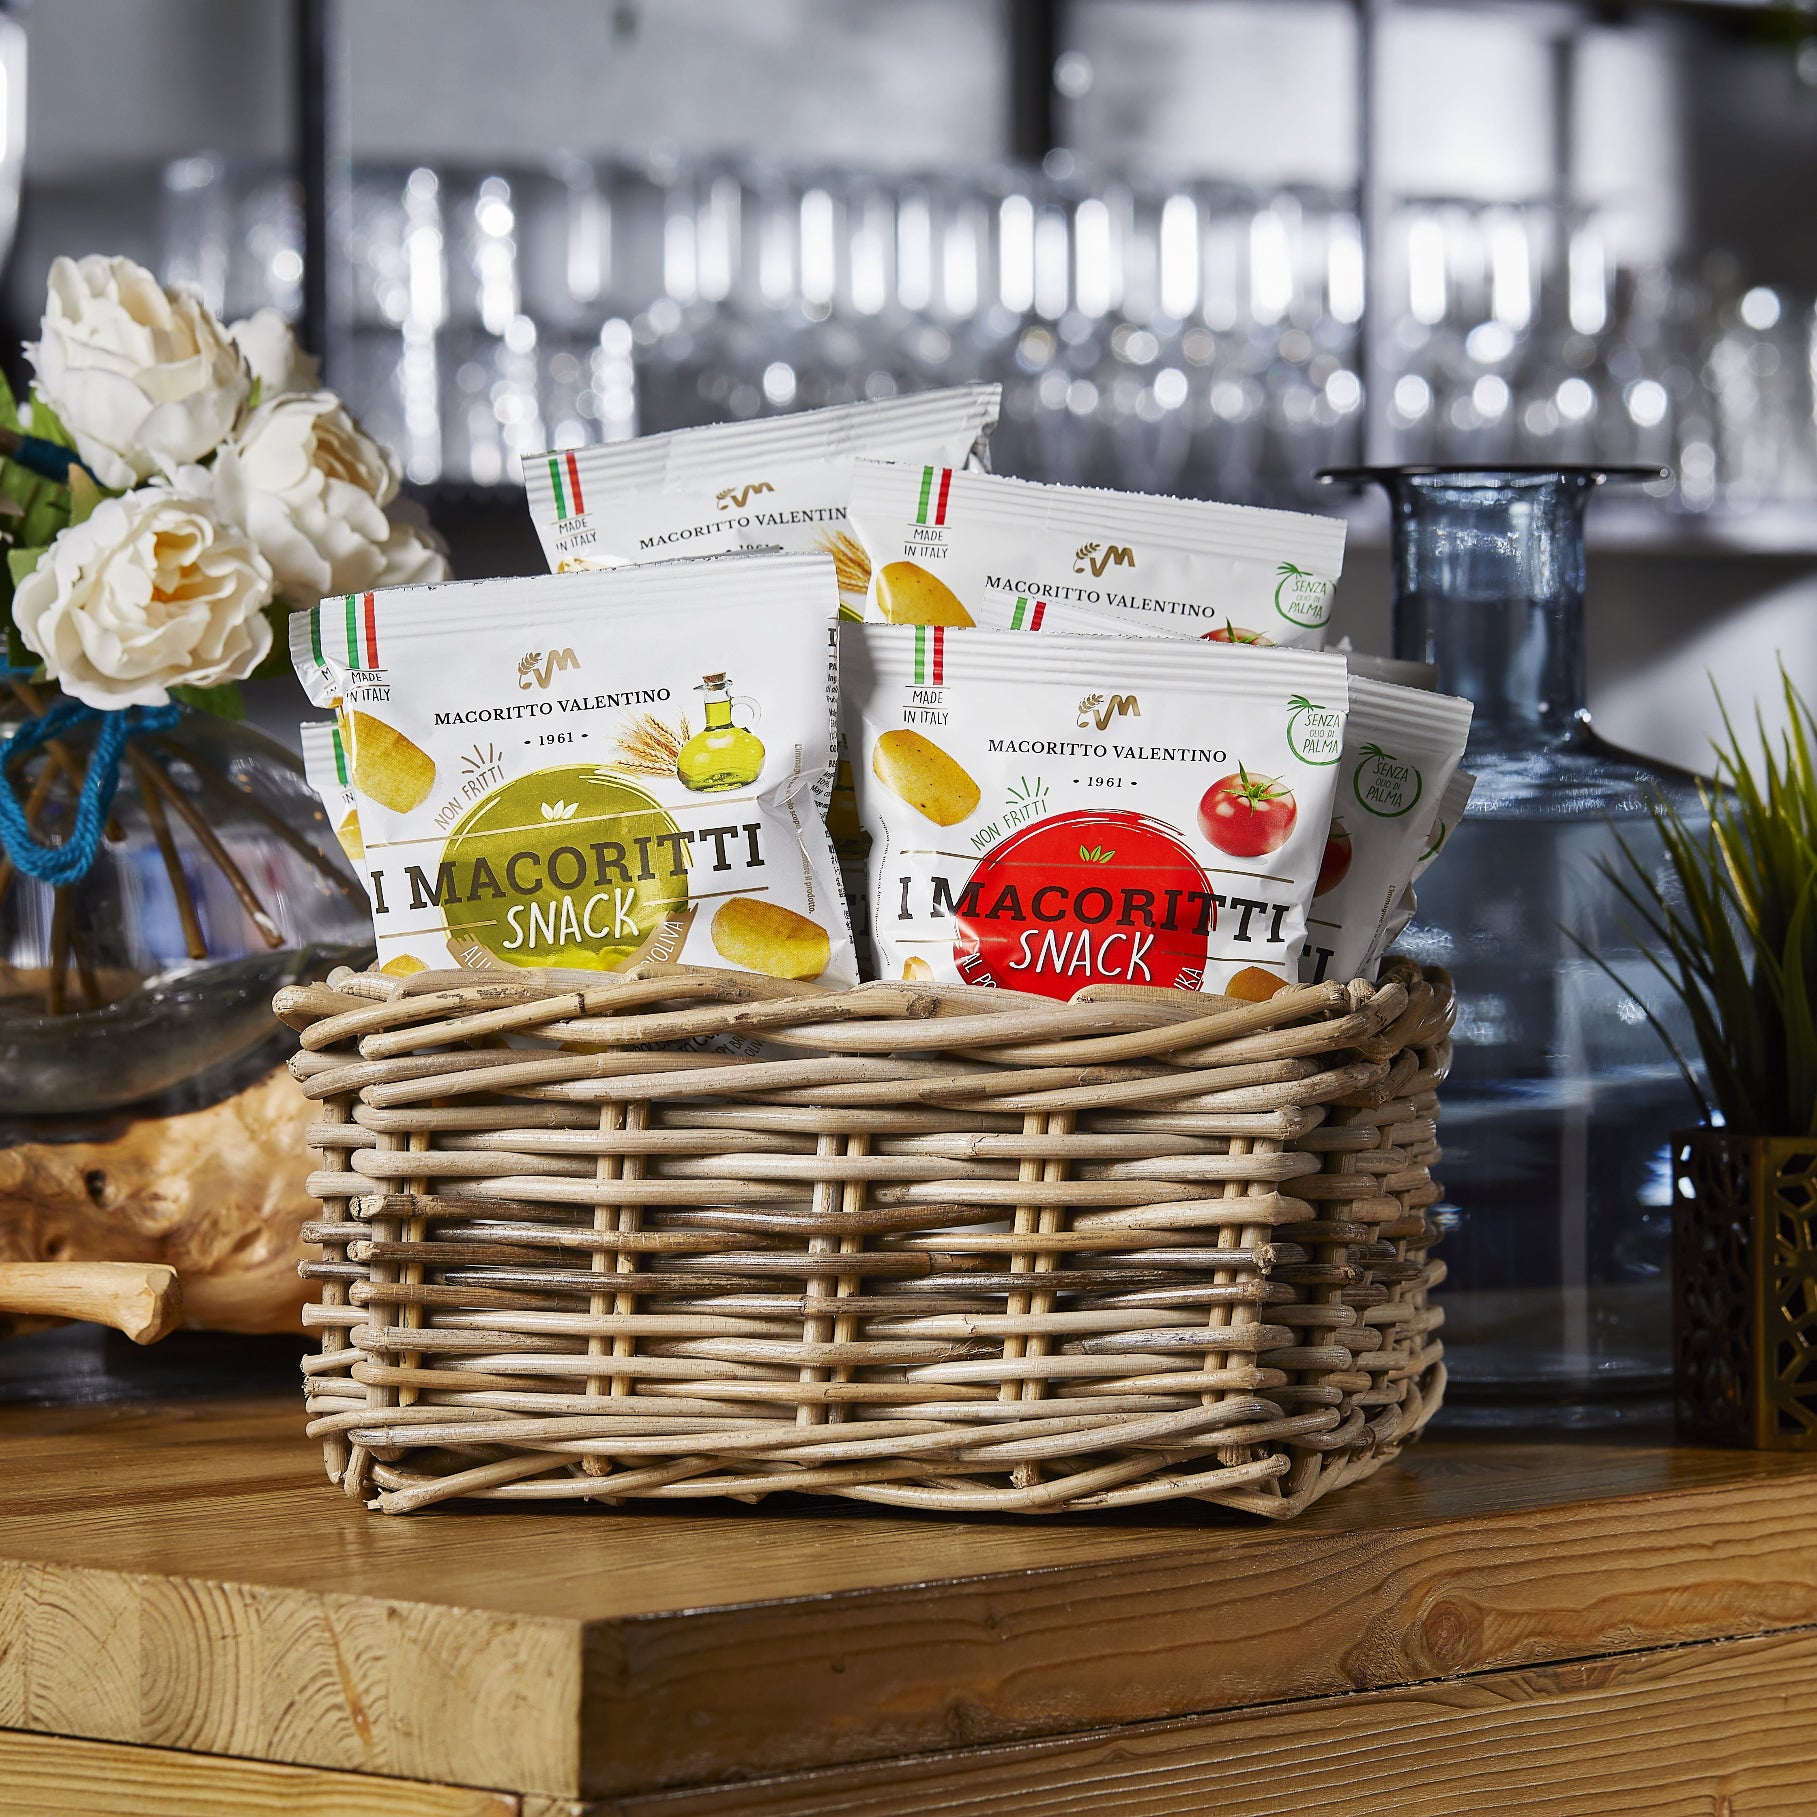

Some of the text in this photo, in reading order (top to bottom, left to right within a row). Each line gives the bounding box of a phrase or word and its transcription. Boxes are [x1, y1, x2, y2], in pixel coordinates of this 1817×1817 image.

[558, 518, 588, 534] MADE
[639, 506, 848, 550] MACORITTO VALENTIN
[912, 528, 944, 542] MADE
[555, 531, 597, 552] IN ITALY
[904, 545, 949, 560] IN ITALY
[1292, 580, 1327, 595] SENZA
[985, 575, 1216, 620] MACORITTO VALENTINO
[1288, 601, 1323, 620] PALMA
[351, 671, 382, 684] MADE
[362, 688, 390, 702] ITALY
[912, 689, 944, 704] MADE
[434, 687, 671, 727] MACORITTO VALENTINO
[903, 710, 949, 726] IN ITALY
[1304, 713, 1341, 728] SENZA
[538, 731, 575, 747] 1961
[1309, 729, 1325, 738] OLIO
[988, 739, 1228, 764] MACORITTO VALENTINO
[1302, 739, 1339, 754] PALMA
[1372, 762, 1409, 782] SENZA
[1086, 776, 1124, 789] 1961
[434, 765, 504, 831] NON FRITTI
[1365, 786, 1402, 807] PALMA
[970, 799, 1046, 851] NON FRITTI
[370, 870, 390, 915] I
[404, 822, 766, 910] MACORITTI
[502, 887, 640, 951] SNACK
[898, 876, 914, 921] I
[930, 875, 1291, 945] MACORITTI
[960, 952, 982, 973] AL
[1008, 928, 1155, 982] SNACK
